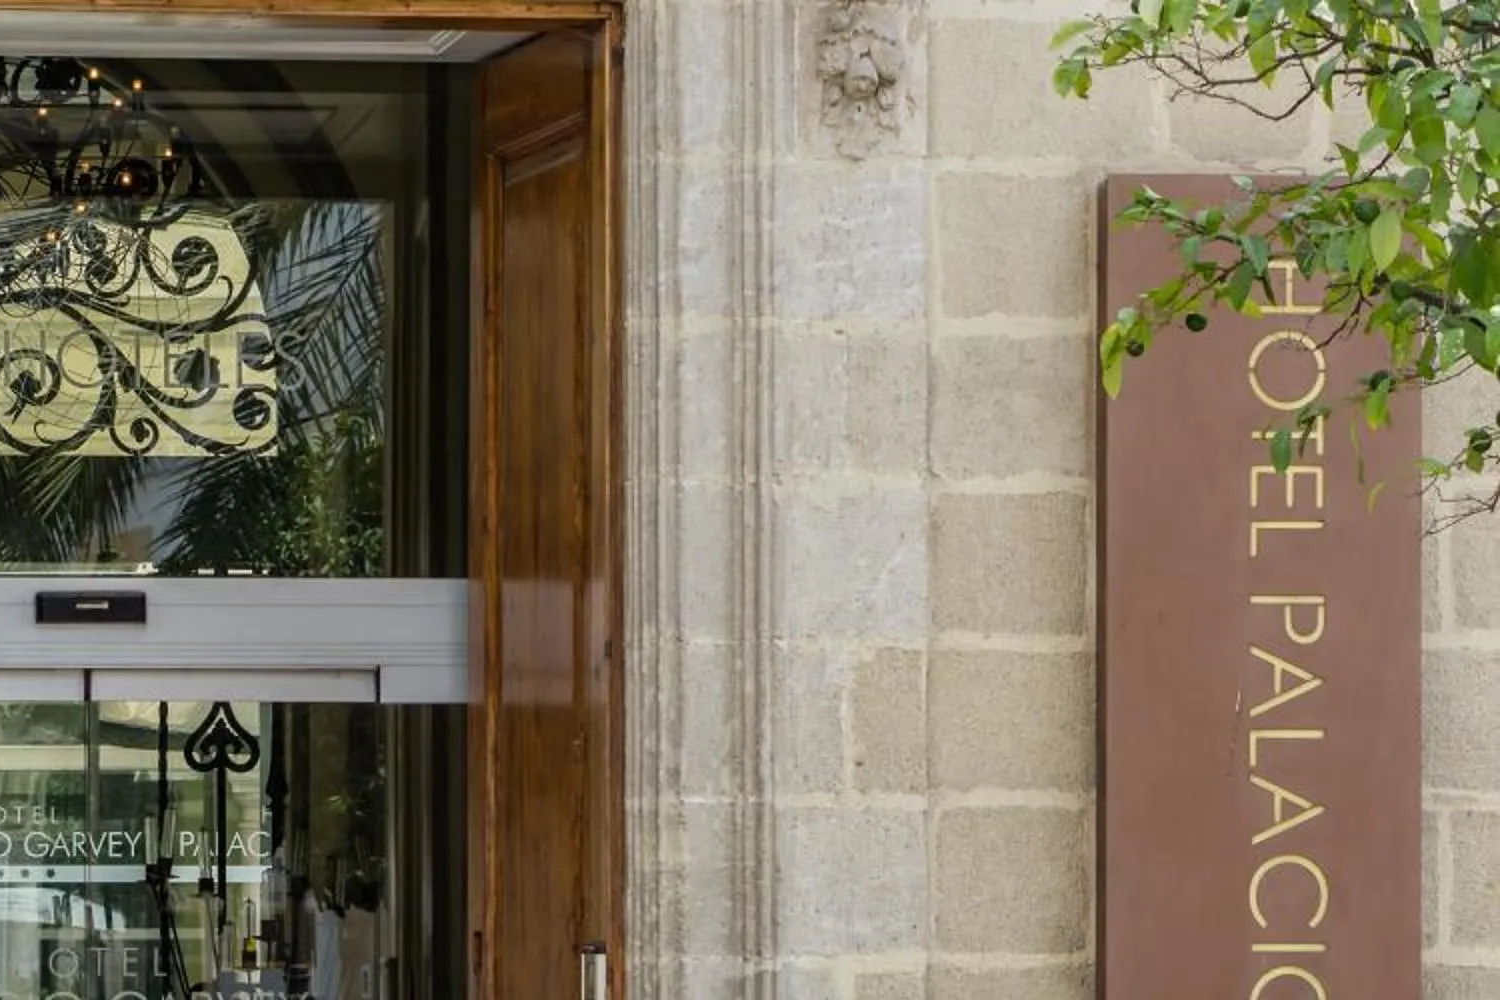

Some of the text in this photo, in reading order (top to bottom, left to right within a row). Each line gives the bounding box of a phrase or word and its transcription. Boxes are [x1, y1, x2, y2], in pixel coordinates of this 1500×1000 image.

[1250, 258, 1326, 558] HOTEL
[23, 831, 143, 858] GARVEY
[18, 946, 168, 979] OTEL
